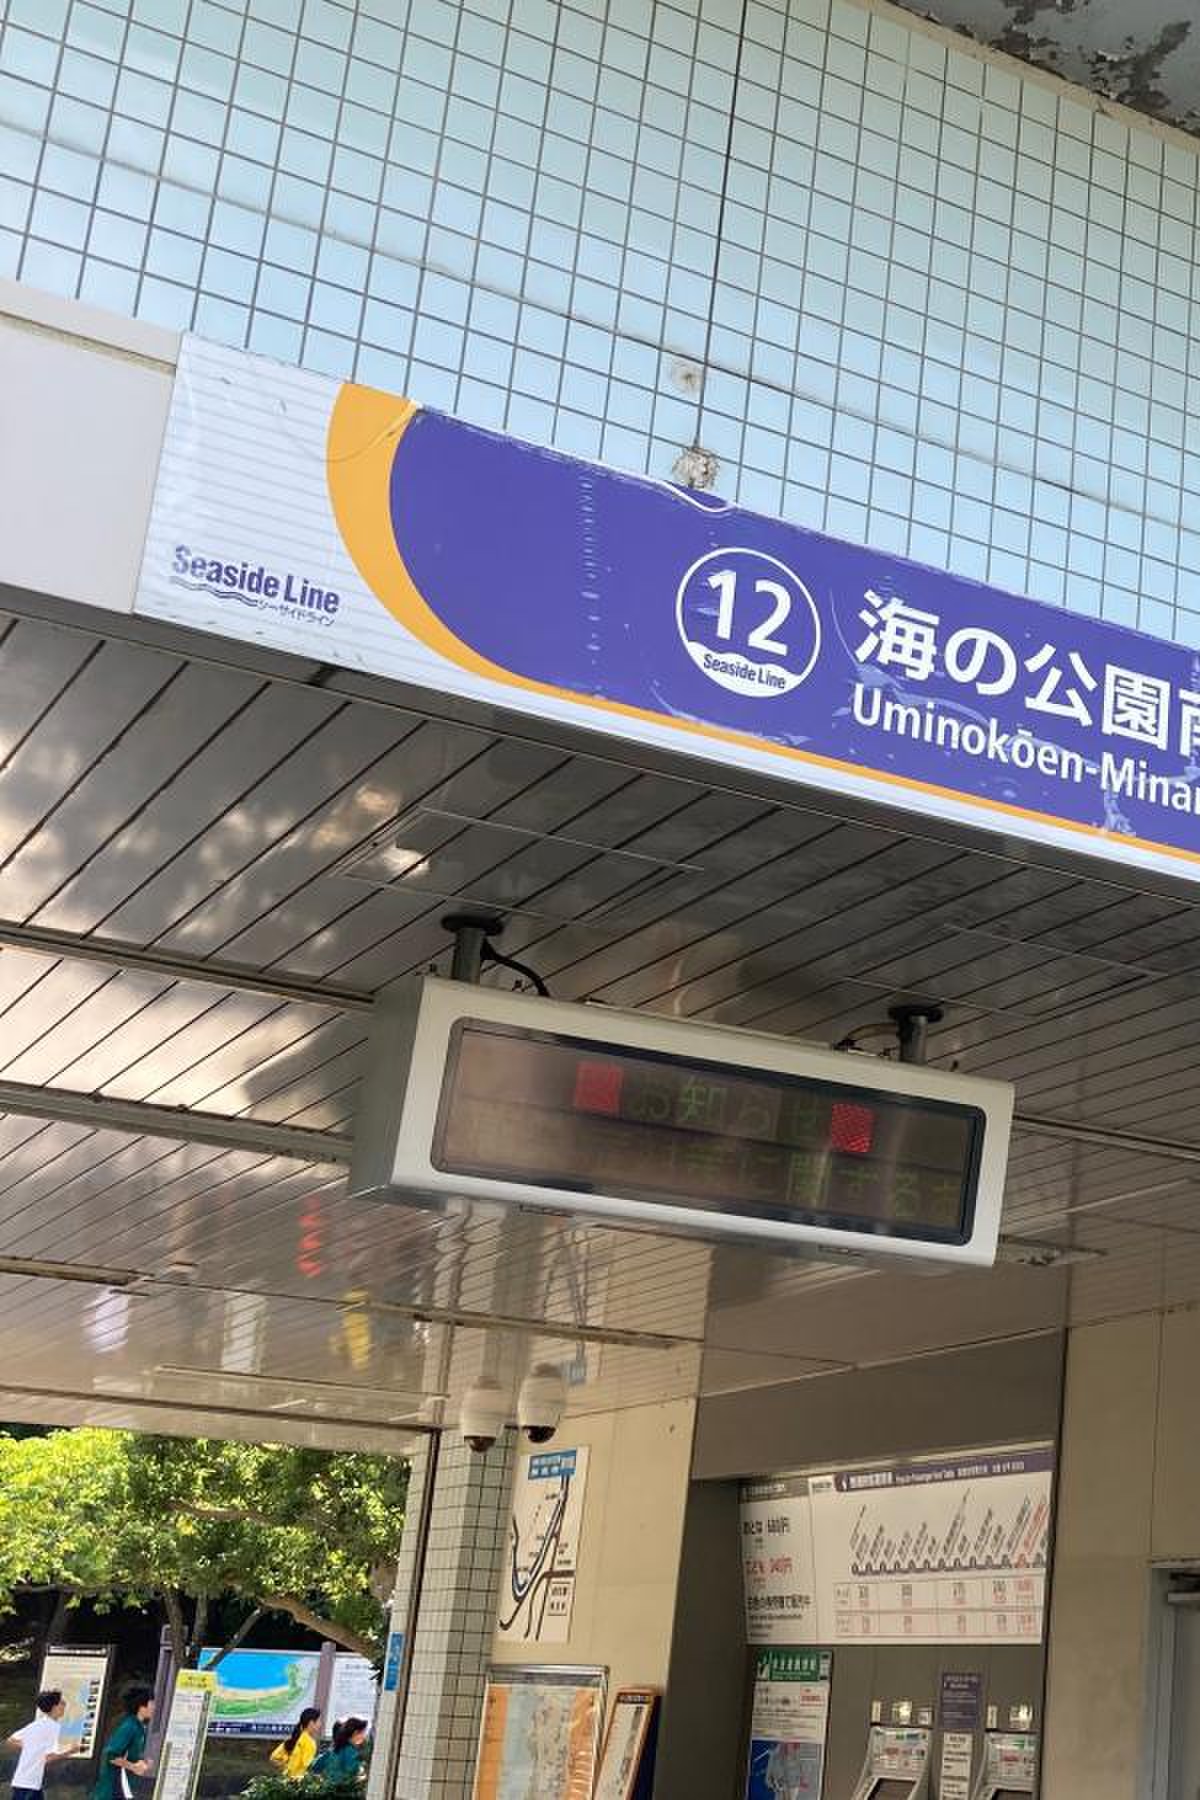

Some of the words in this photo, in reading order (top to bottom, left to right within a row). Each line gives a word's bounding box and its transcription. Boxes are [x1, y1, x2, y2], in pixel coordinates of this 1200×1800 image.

[173, 544, 280, 598] Seaside
[284, 574, 340, 614] Line
[707, 569, 792, 657] 12
[703, 653, 757, 683] Seaside
[758, 667, 787, 690] Line
